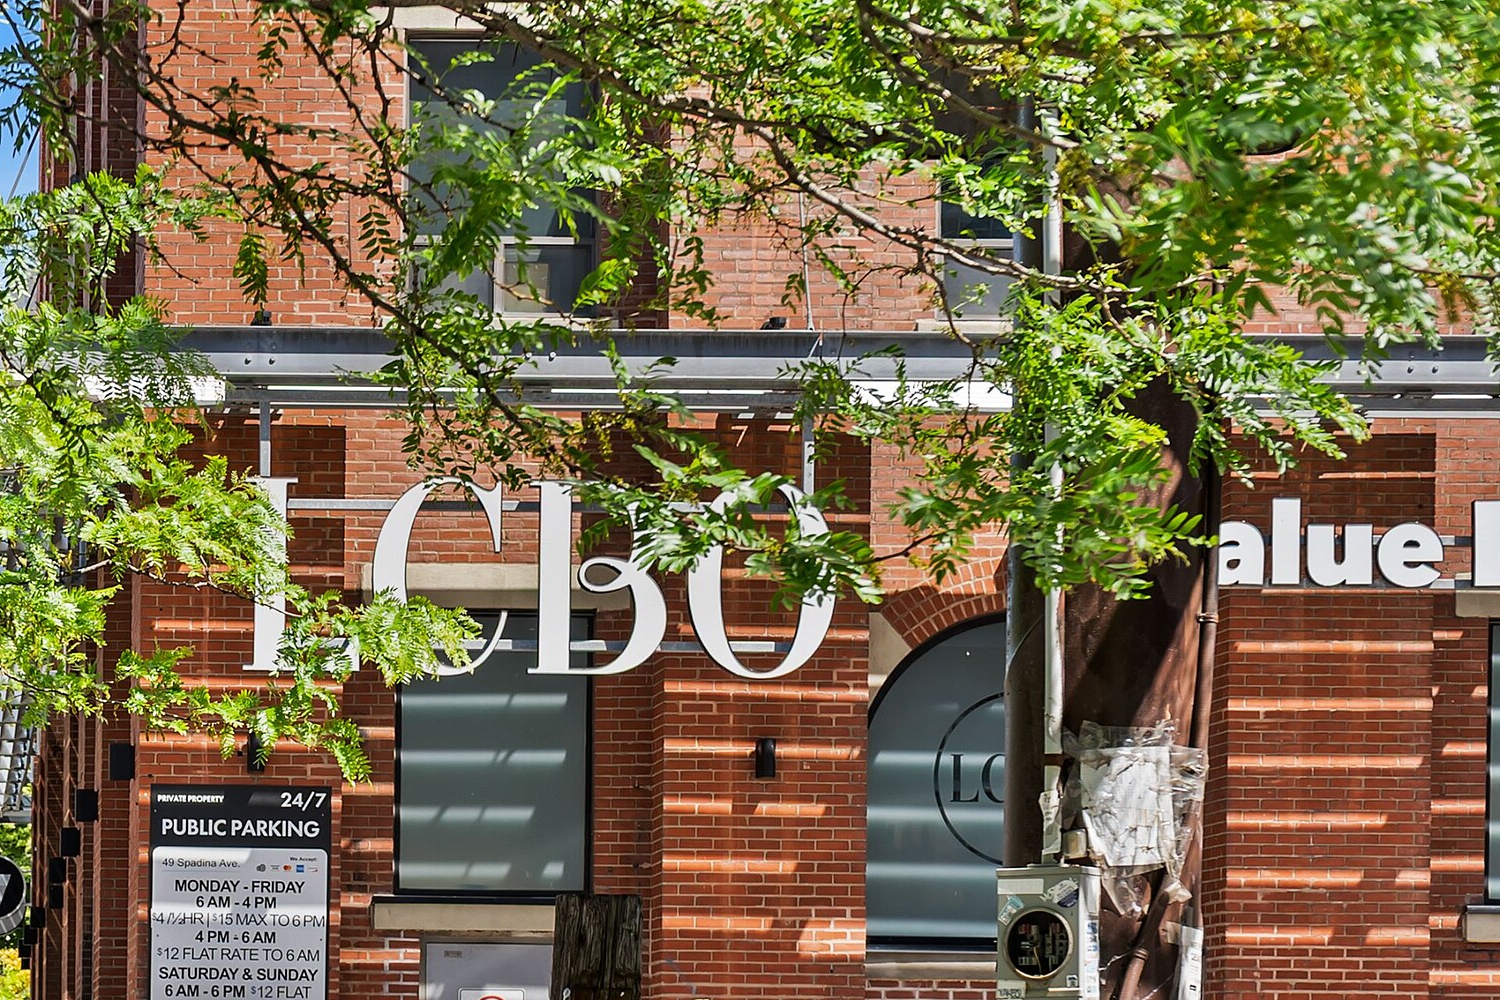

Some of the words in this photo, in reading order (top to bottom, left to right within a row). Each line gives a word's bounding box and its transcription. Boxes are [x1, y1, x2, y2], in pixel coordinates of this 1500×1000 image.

[1218, 497, 1444, 588] alue
[243, 476, 835, 679] LCBO
[157, 794, 187, 803] PRIVATE
[187, 795, 224, 803] PROPERTY
[280, 791, 327, 811] 24/7
[161, 818, 227, 836] PUBLIC
[231, 819, 320, 838] PARKING
[162, 858, 174, 867] 49
[177, 858, 217, 869] Spadina
[219, 859, 240, 868] Ave.
[175, 880, 240, 893] MONDAY
[251, 881, 305, 894] FRIDAY
[196, 896, 204, 908] 6
[207, 896, 230, 908] AM
[242, 897, 251, 908] 4
[254, 897, 277, 908] PM
[212, 913, 233, 926] $15
[235, 914, 267, 927] MAX
[270, 915, 289, 927] TO
[292, 915, 301, 927] 6
[304, 915, 325, 927] PM
[195, 931, 204, 942] 4
[207, 931, 230, 943] PM
[242, 931, 250, 943] 6
[252, 932, 276, 943] AM
[157, 947, 179, 960] $12
[182, 948, 217, 960] FLAT
[221, 949, 259, 961] RATE
[264, 949, 283, 961] TO
[286, 949, 294, 961] 6
[297, 950, 320, 962] AM
[159, 967, 239, 980] SATURDAY
[242, 968, 253, 980] &
[256, 969, 318, 981] SUNDAY
[165, 984, 173, 996] 6
[175, 985, 199, 997] AM
[211, 985, 219, 997] 6
[223, 985, 245, 997] PM
[251, 986, 273, 998] $12
[276, 986, 311, 998] FLAT
